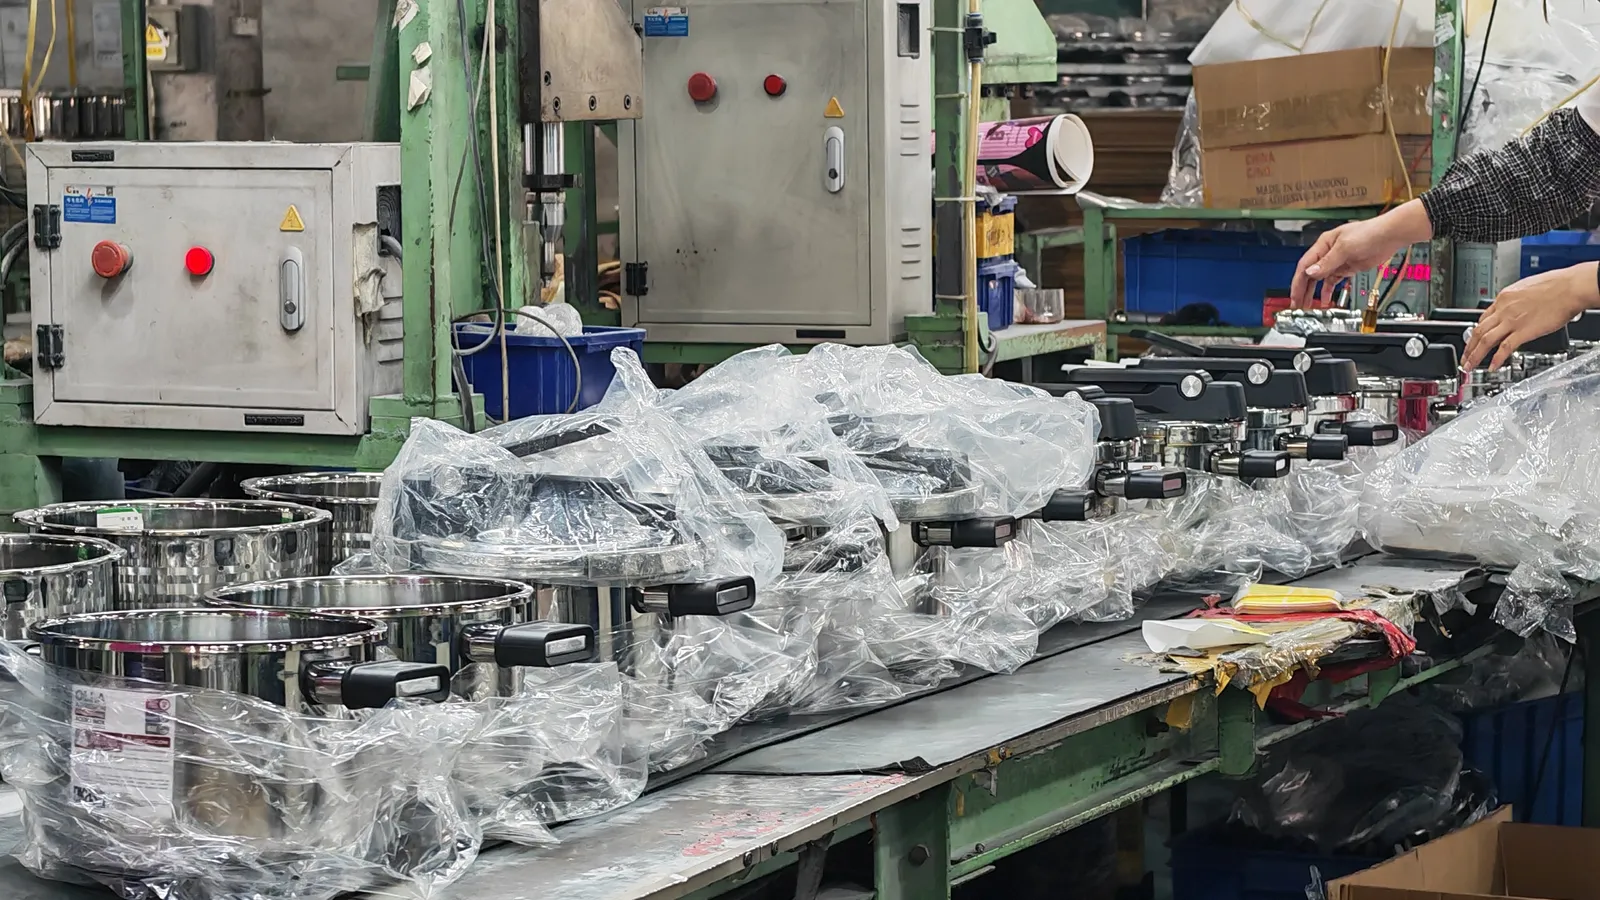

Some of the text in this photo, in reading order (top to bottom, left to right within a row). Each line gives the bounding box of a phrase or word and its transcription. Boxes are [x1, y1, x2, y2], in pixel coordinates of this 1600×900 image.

[1245, 150, 1275, 165] CHINA
[1256, 176, 1349, 195] MADE IN GUANGDONG
